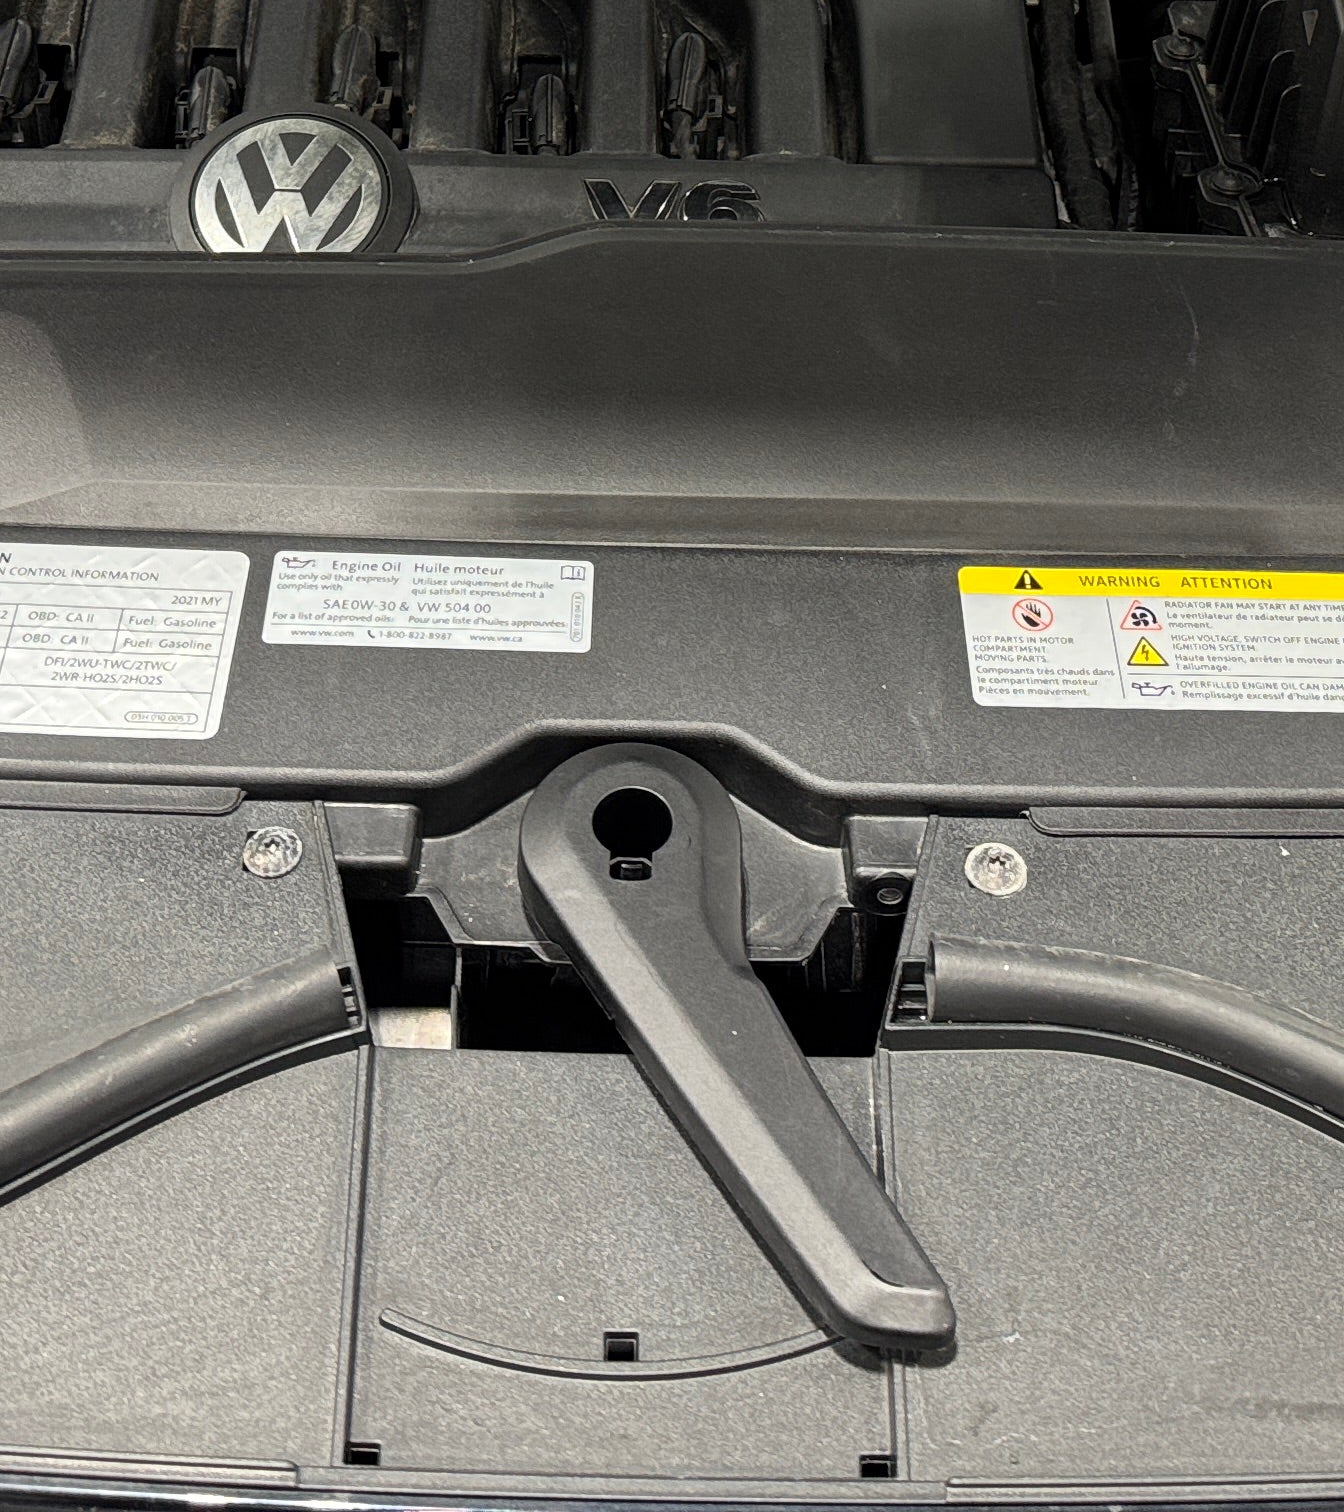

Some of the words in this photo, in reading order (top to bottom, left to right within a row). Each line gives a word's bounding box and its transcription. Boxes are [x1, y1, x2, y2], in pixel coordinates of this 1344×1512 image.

[8, 566, 67, 578] CONTROL
[70, 568, 160, 582] INFORMATION
[170, 595, 199, 606] 2021
[200, 596, 223, 607] MY
[398, 601, 410, 612] &
[65, 612, 84, 623] CA
[86, 613, 95, 623] II
[162, 616, 217, 629] Gasoline
[59, 634, 78, 645] CA
[80, 635, 90, 645] II
[158, 638, 213, 651] Gasoline
